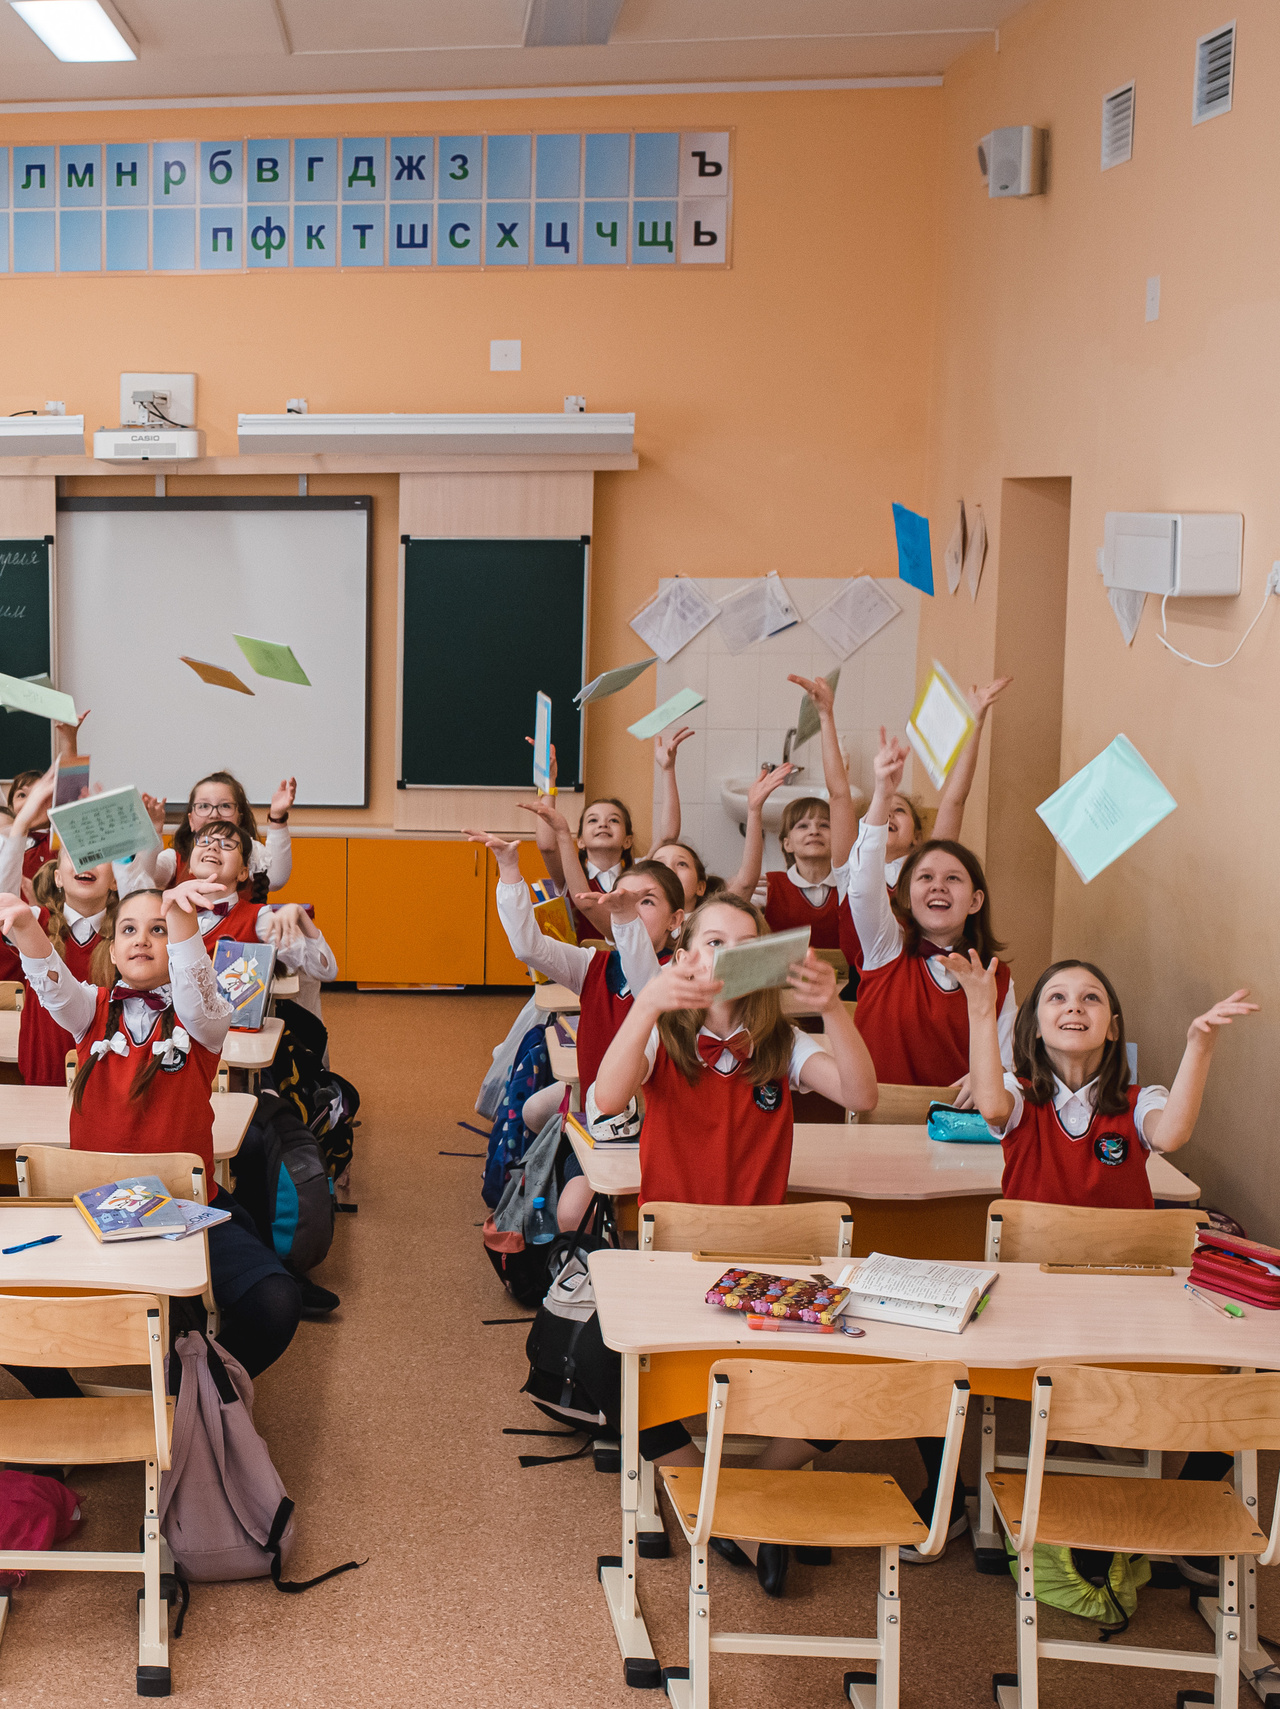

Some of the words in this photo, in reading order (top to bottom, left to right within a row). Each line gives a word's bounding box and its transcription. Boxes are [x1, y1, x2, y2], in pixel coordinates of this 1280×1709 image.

[22, 164, 45, 189] л
[68, 163, 93, 187] м
[116, 162, 137, 186] н
[164, 161, 186, 195] р
[209, 149, 232, 184] б
[257, 158, 279, 182] в
[308, 157, 323, 181] г
[348, 156, 375, 187] д
[395, 155, 425, 180] ж
[449, 154, 468, 180] з
[691, 151, 722, 177] ъ
[213, 227, 232, 251] п
[251, 216, 285, 259] ф
[307, 225, 325, 249] к
[353, 225, 373, 249] т
[397, 224, 428, 248] ш
[449, 223, 470, 248] с
[496, 223, 518, 247] х
[546, 222, 569, 253] ц
[596, 222, 617, 246] ч
[639, 221, 675, 254] щ
[694, 221, 717, 246] ь
